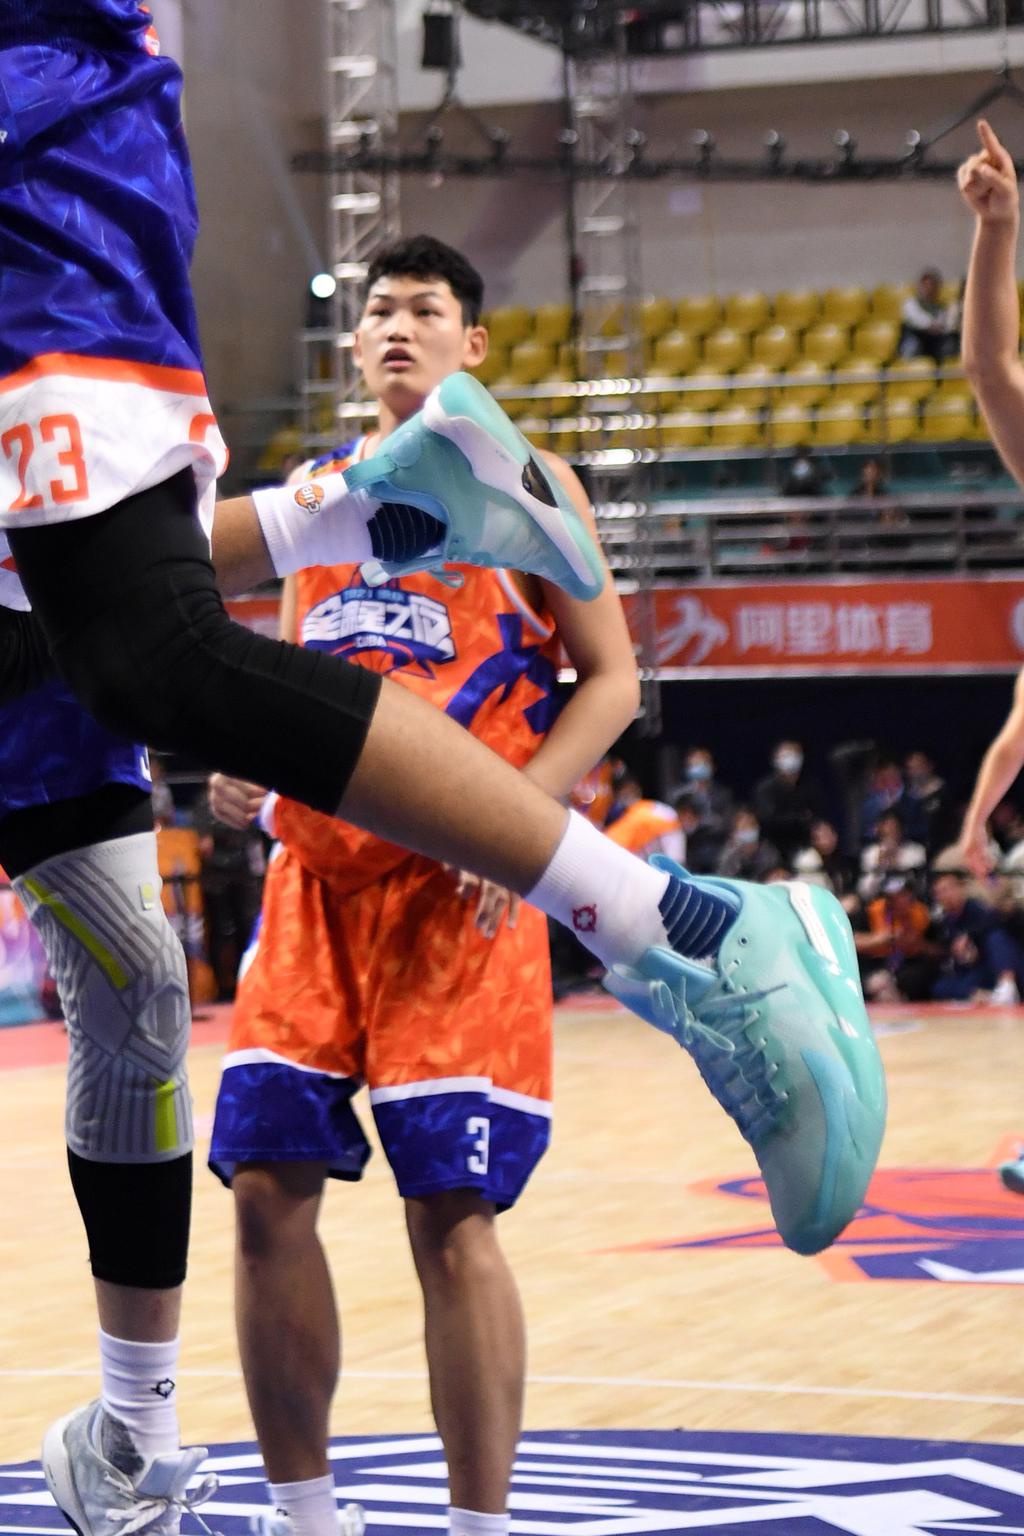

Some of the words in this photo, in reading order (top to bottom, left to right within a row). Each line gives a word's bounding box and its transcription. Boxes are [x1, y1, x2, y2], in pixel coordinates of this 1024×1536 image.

[1, 413, 89, 512] 23
[734, 601, 933, 656] 阿里体育
[465, 1116, 490, 1175] 3
